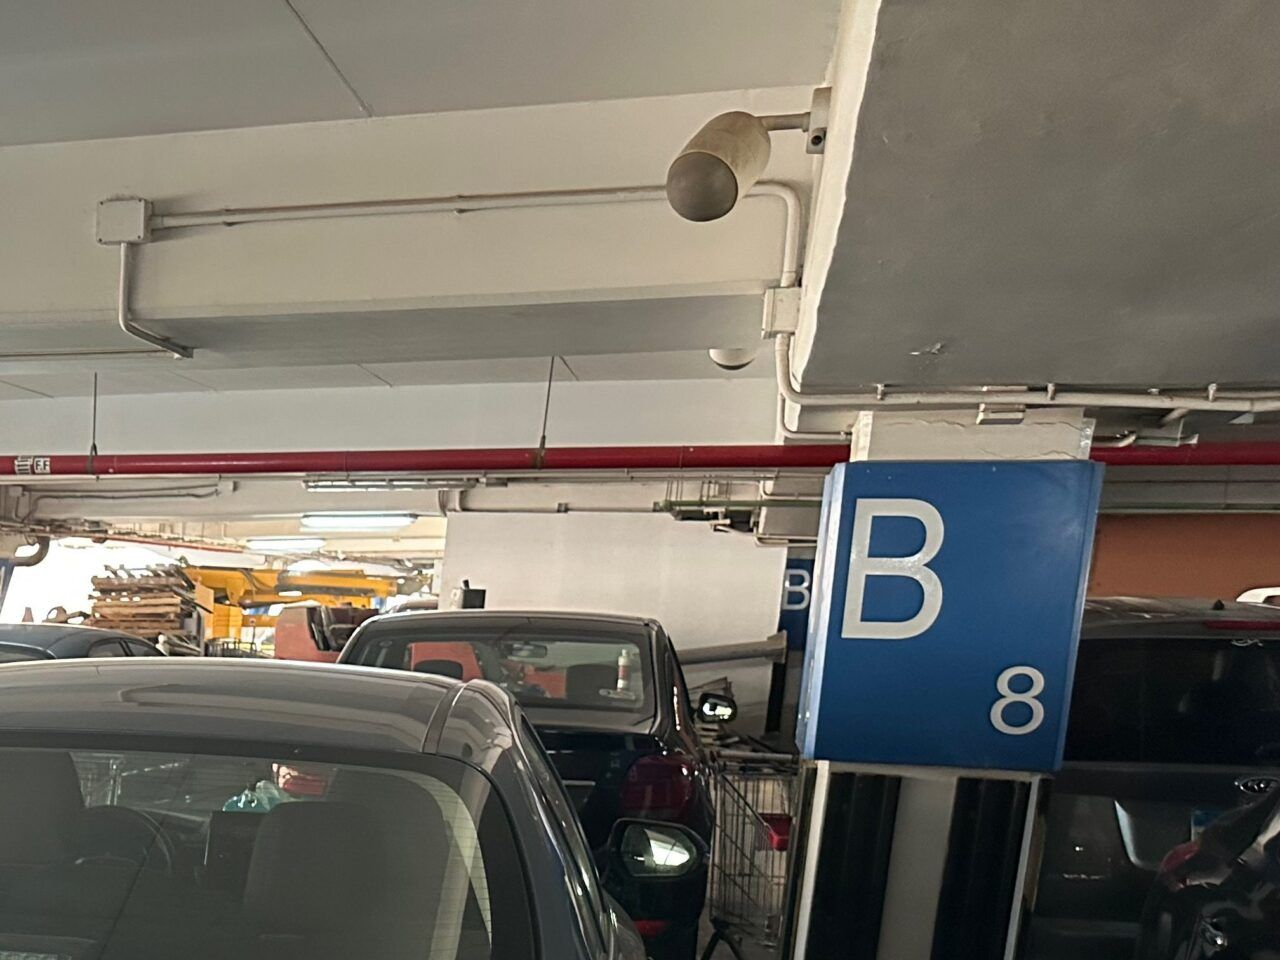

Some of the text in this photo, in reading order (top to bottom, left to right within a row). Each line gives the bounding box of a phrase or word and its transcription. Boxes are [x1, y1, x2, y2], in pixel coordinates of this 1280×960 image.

[782, 569, 811, 610] B
[841, 498, 945, 640] B
[990, 666, 1045, 735] 8
